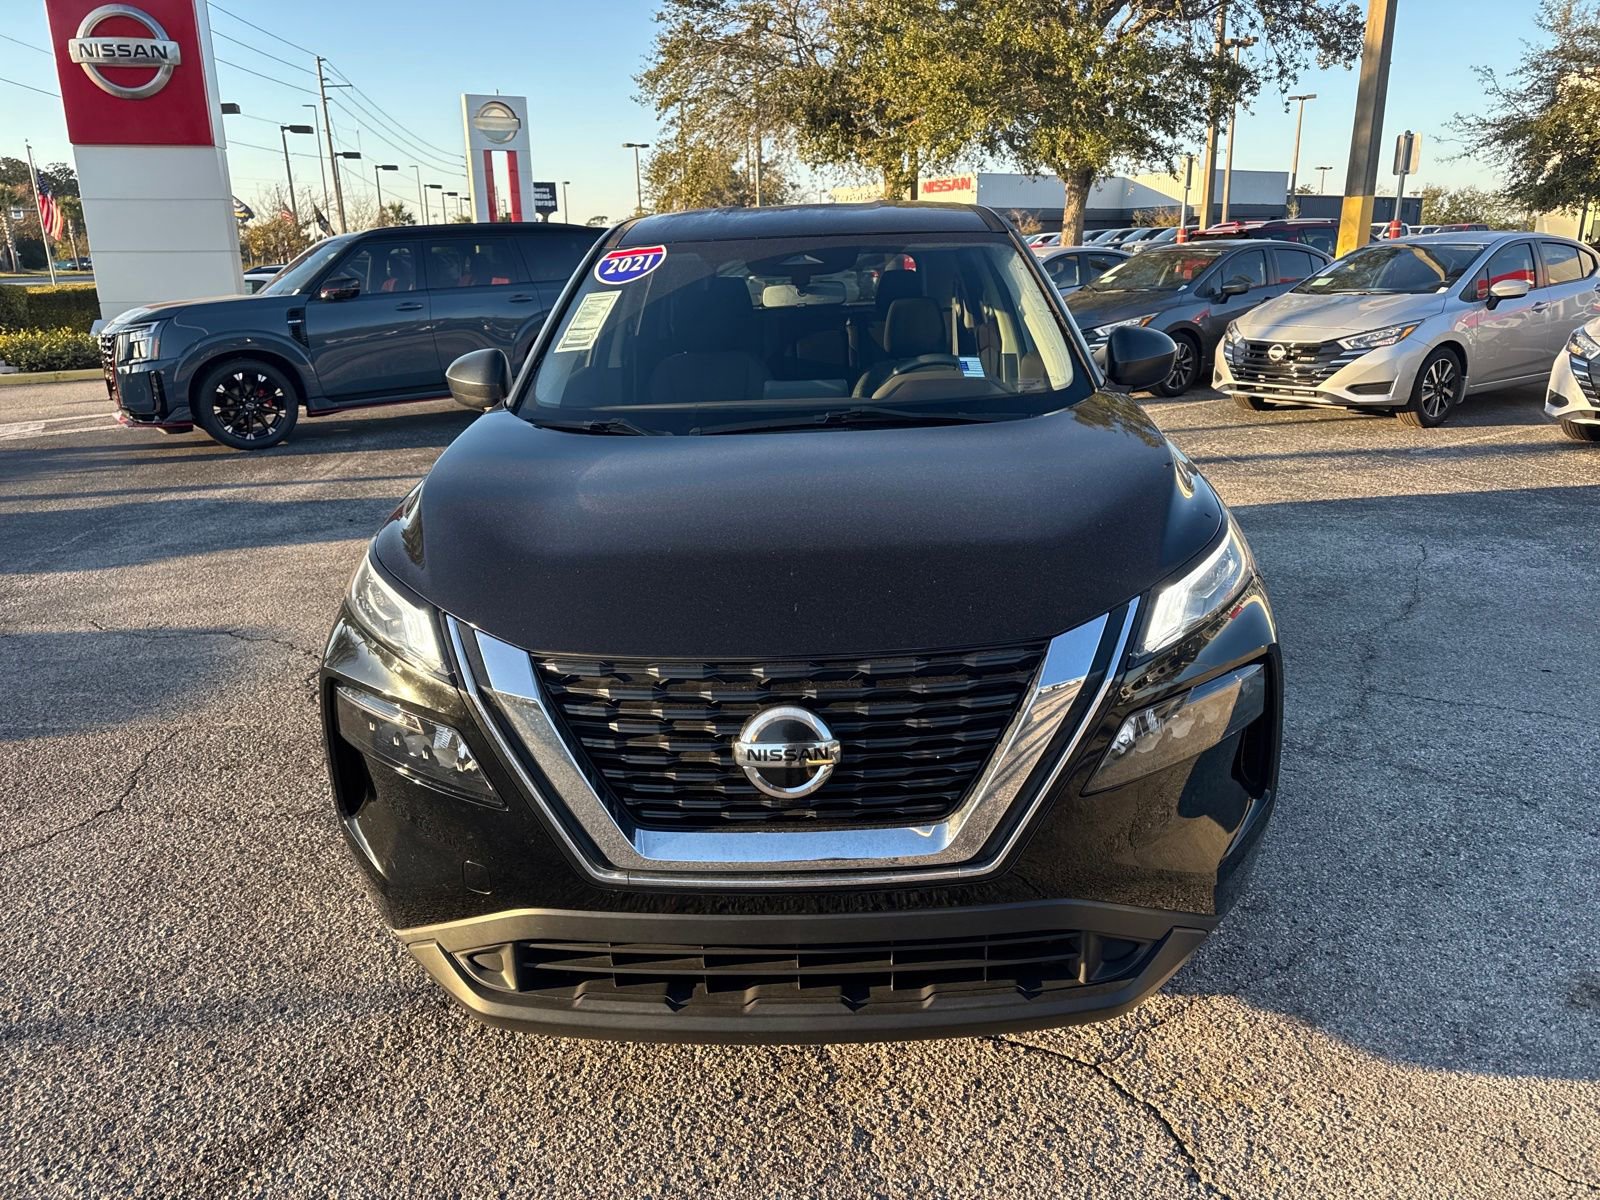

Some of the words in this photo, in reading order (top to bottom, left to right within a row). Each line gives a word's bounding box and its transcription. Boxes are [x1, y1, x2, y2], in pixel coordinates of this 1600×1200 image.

[79, 43, 168, 59] NISSAN
[923, 177, 971, 193] NISSAN
[603, 254, 654, 275] 2021
[747, 747, 829, 762] NISSAN
